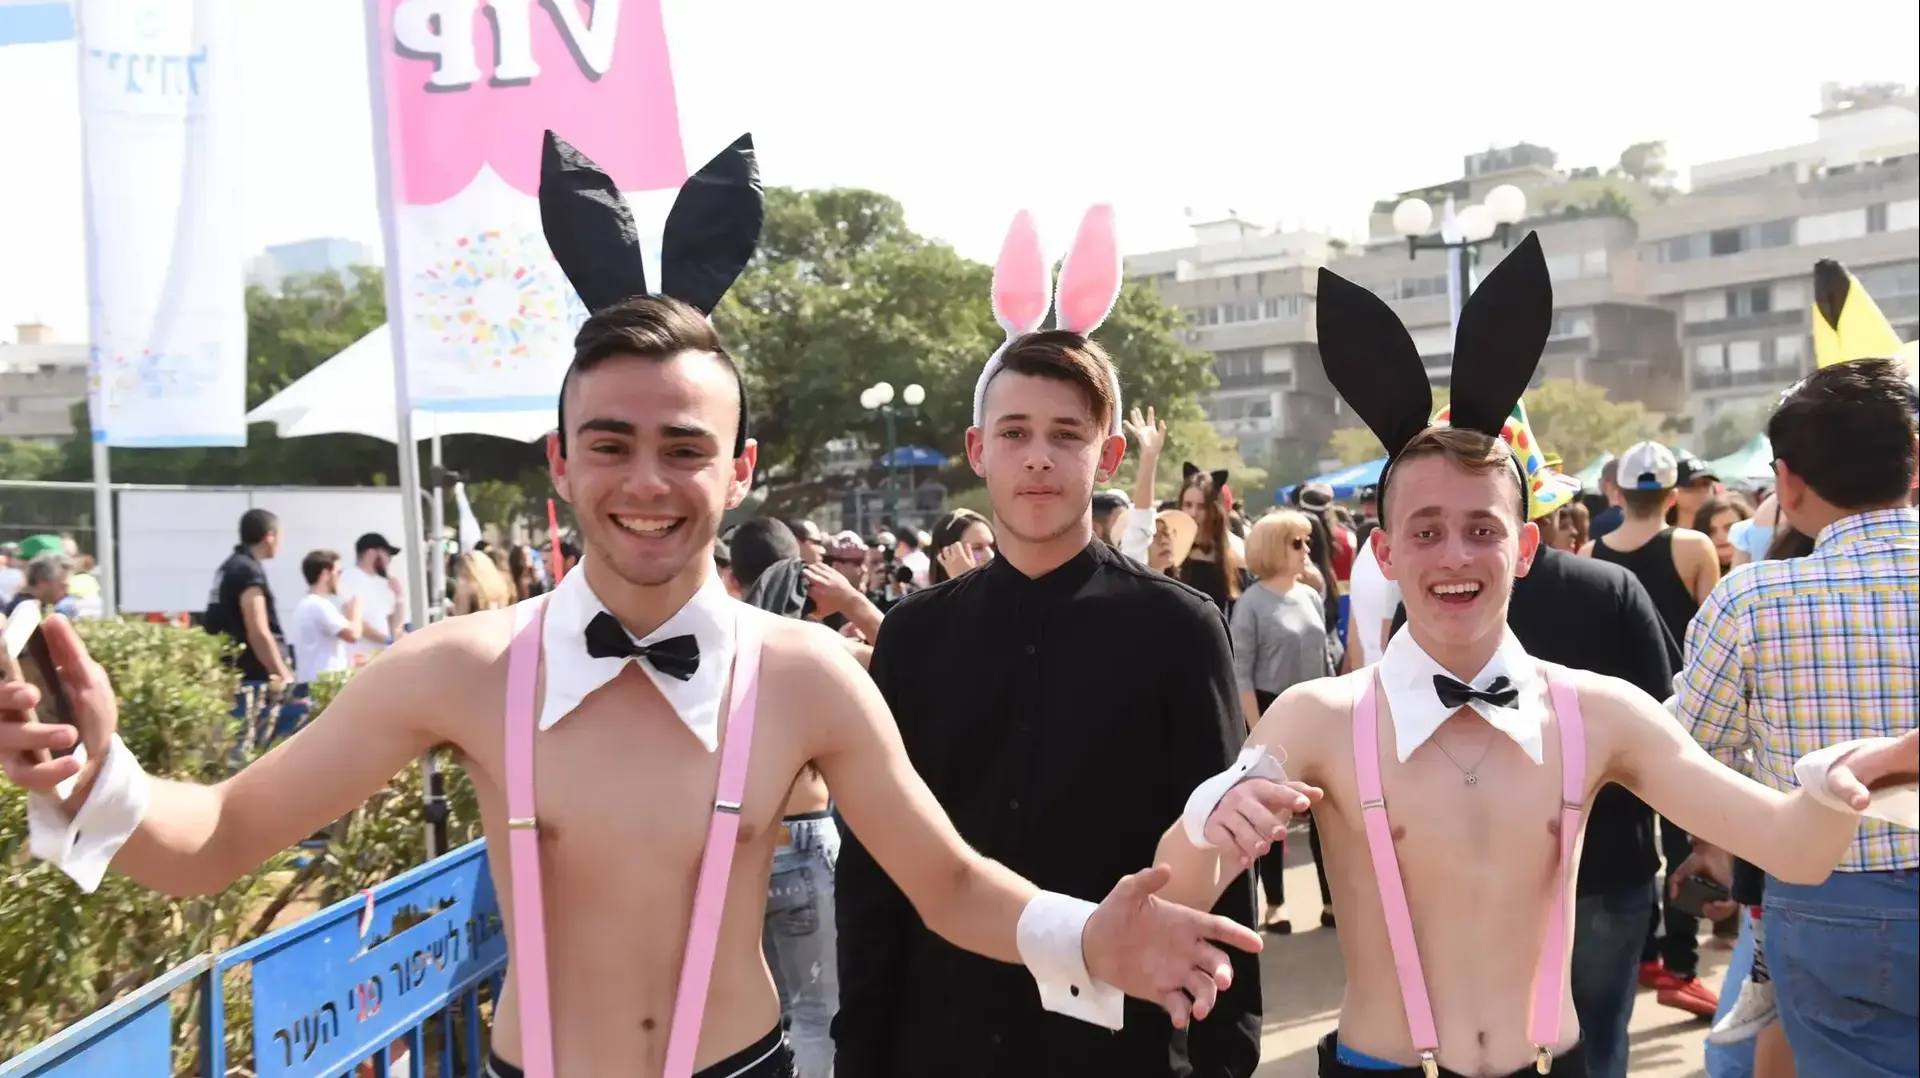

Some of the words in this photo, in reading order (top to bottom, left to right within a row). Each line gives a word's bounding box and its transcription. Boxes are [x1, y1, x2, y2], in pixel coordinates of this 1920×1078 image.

[388, 919, 460, 997] לשיפור
[348, 974, 384, 1024] פני
[272, 1000, 339, 1068] העיר
